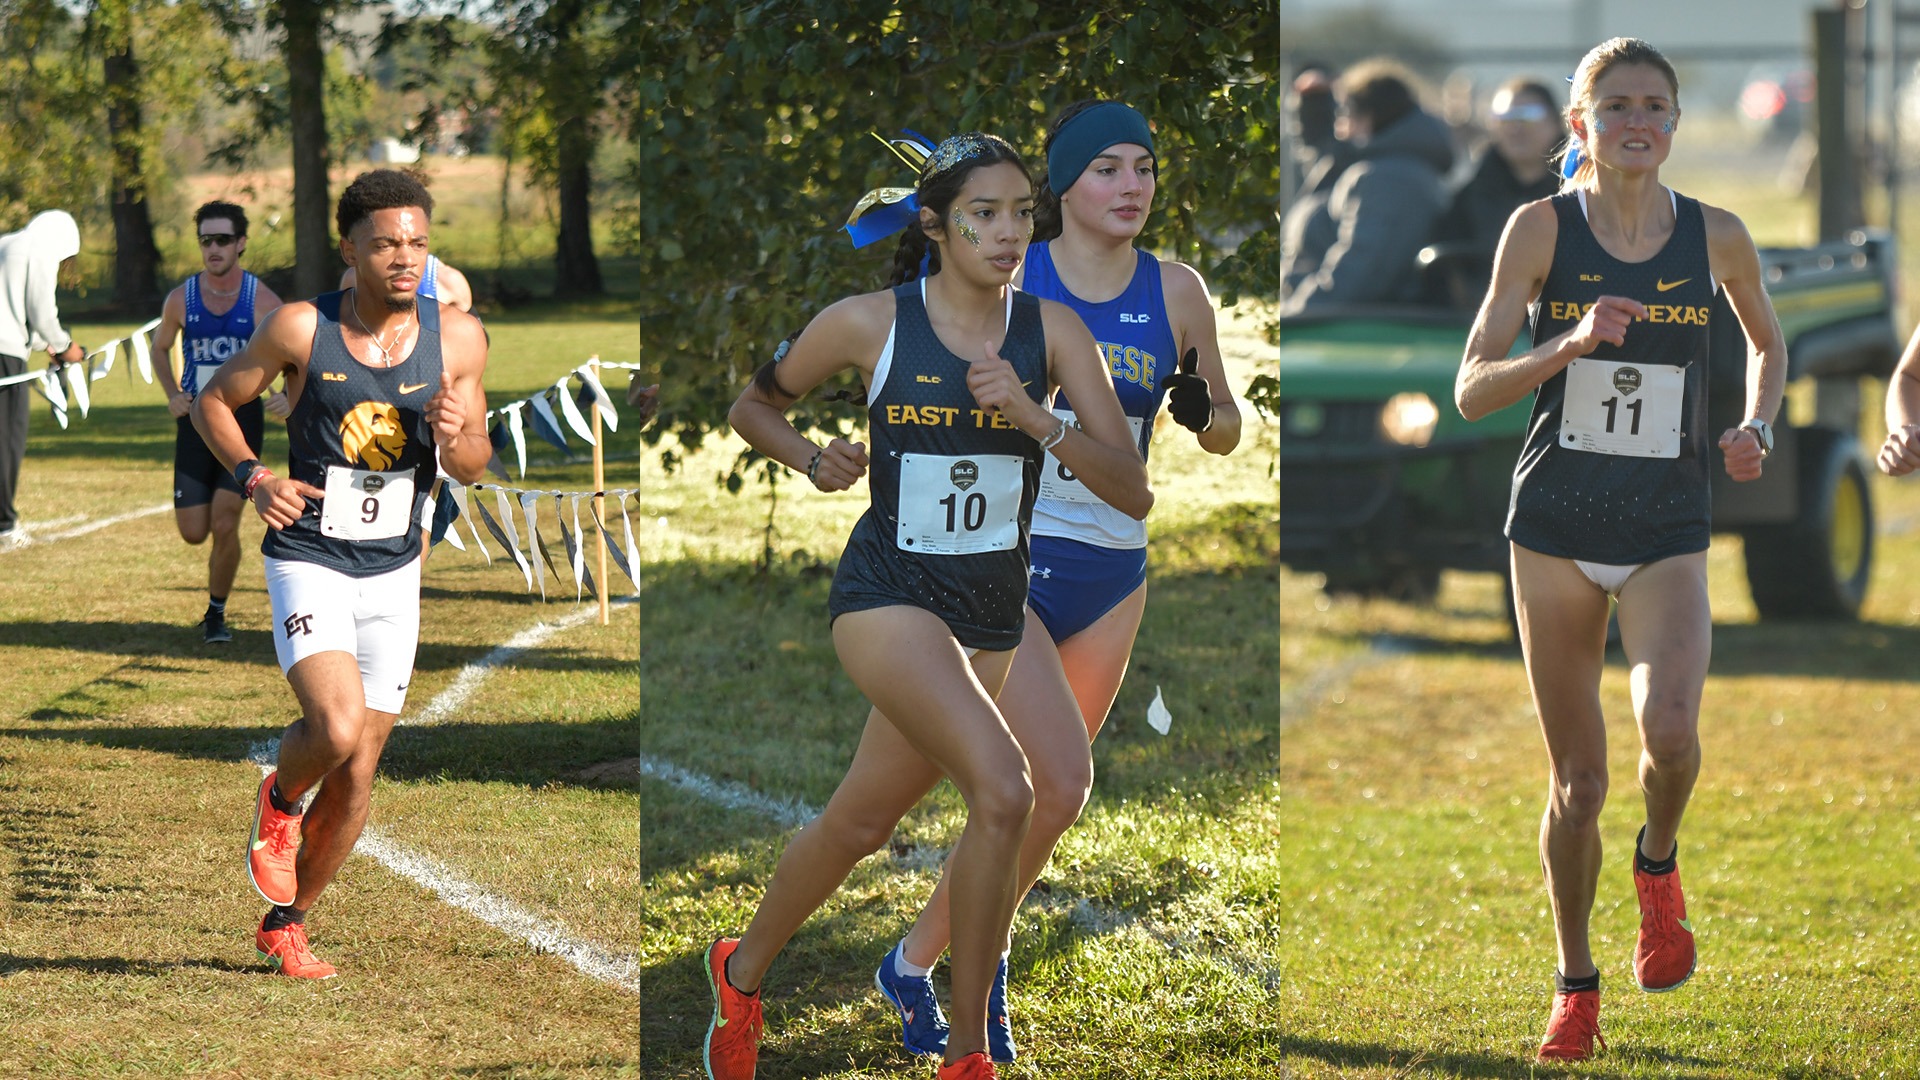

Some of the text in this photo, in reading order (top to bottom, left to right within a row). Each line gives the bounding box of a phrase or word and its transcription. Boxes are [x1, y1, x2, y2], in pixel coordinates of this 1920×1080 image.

[1120, 313, 1151, 324] SLC
[916, 375, 942, 384] SLC
[1096, 341, 1156, 393] ESE
[886, 405, 1017, 429] EAST TE
[1601, 396, 1643, 436] 11
[360, 497, 380, 524] 9
[939, 492, 987, 533] 10
[283, 612, 313, 640] ET
